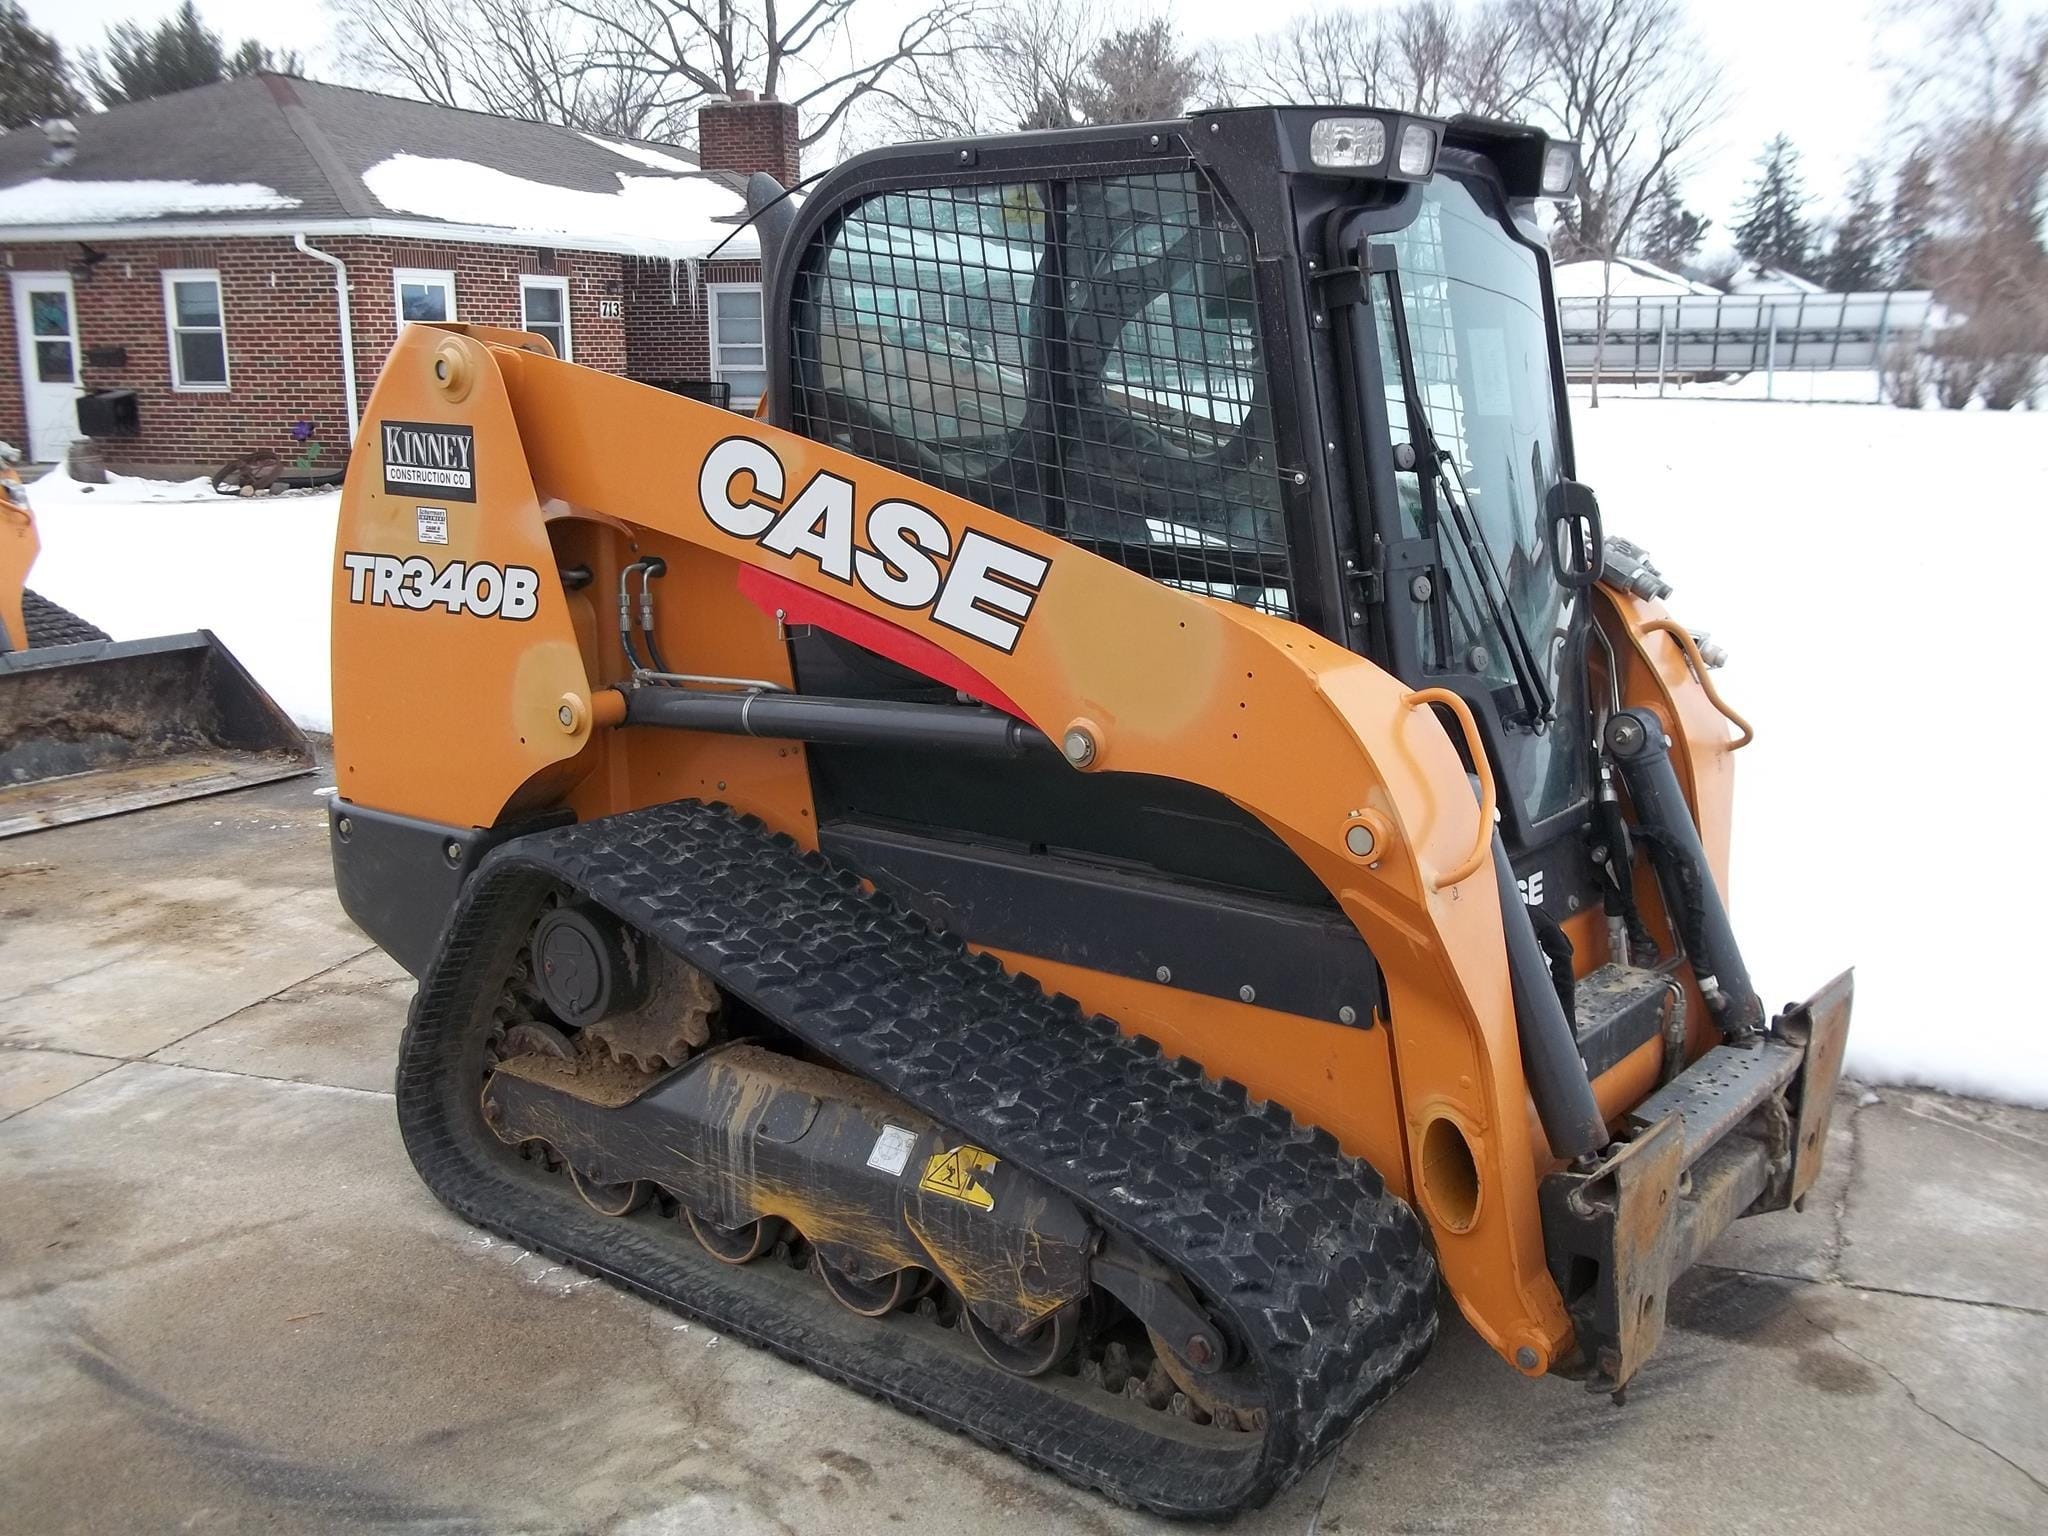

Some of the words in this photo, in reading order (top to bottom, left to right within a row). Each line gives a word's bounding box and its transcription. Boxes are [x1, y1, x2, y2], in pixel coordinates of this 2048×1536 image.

[602, 301, 620, 317] 713
[384, 425, 472, 470] KINNEY
[390, 468, 451, 484] CONSTRUCTION
[453, 473, 468, 486] CO.
[698, 434, 1053, 655] CASE
[344, 551, 540, 622] TR340B
[1517, 870, 1544, 906] SE
